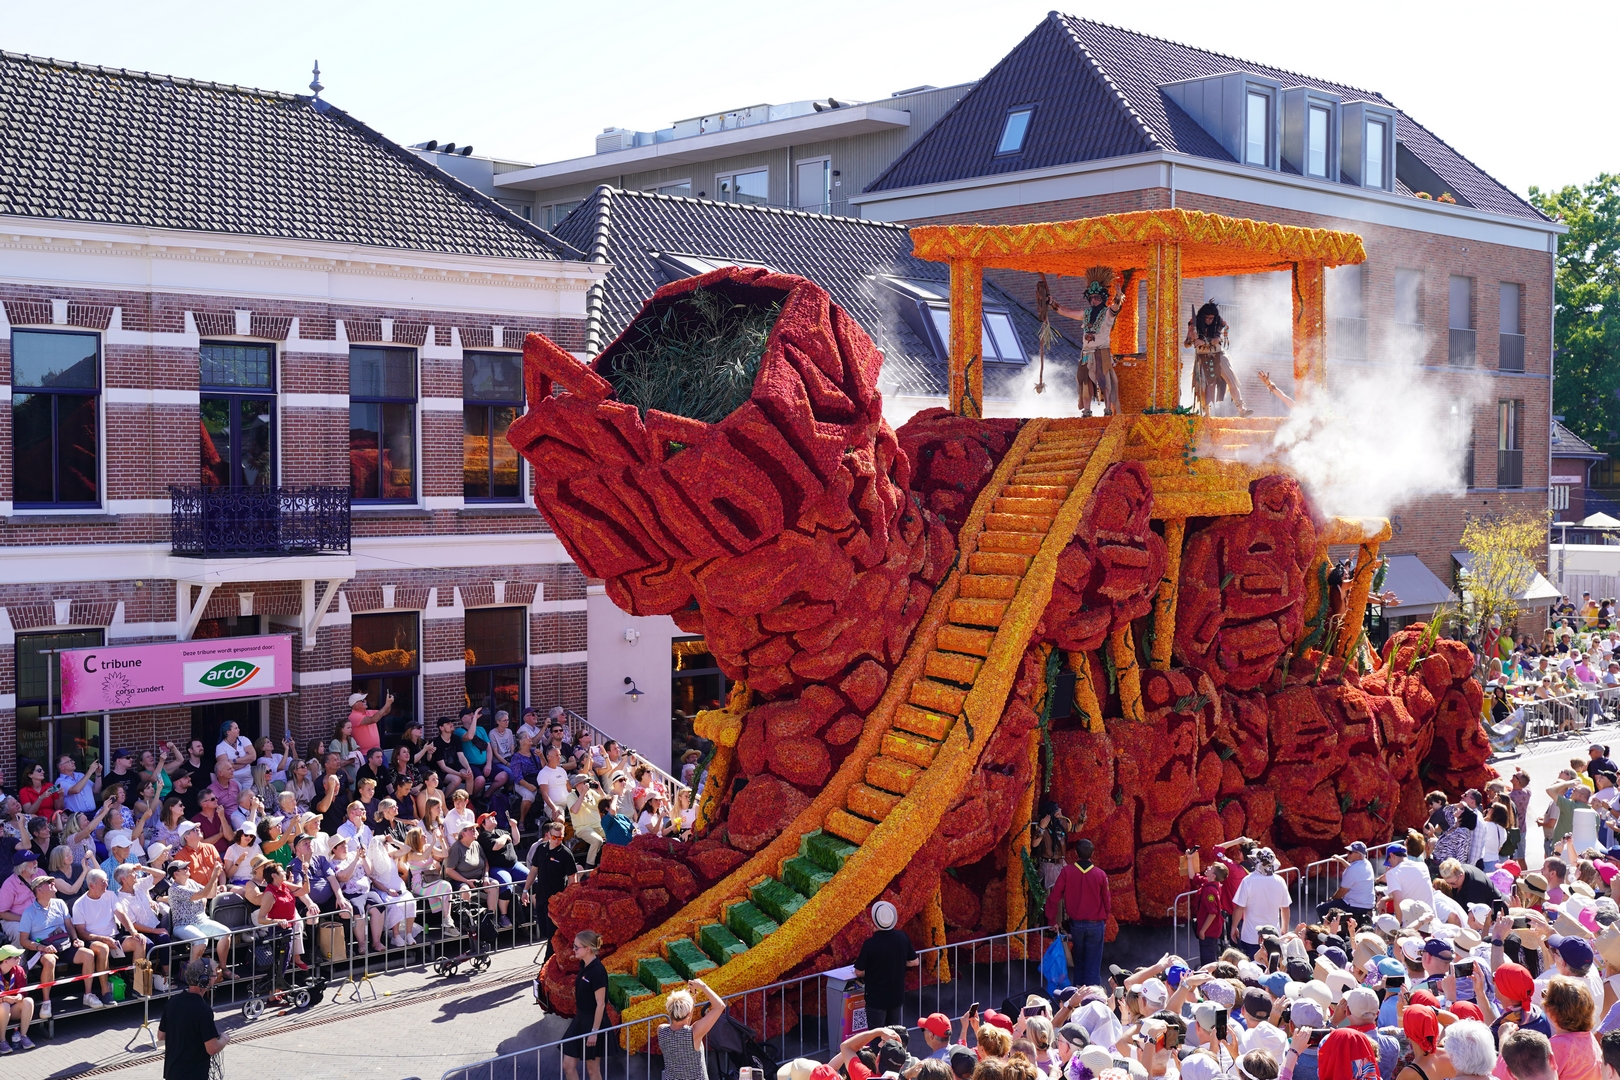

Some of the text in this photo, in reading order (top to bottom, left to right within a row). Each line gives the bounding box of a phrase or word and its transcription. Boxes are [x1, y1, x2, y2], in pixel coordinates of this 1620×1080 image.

[83, 655, 142, 673] C tribune
[207, 666, 246, 680] ardo
[137, 685, 164, 693] zundert
[35, 739, 48, 748] GOG
